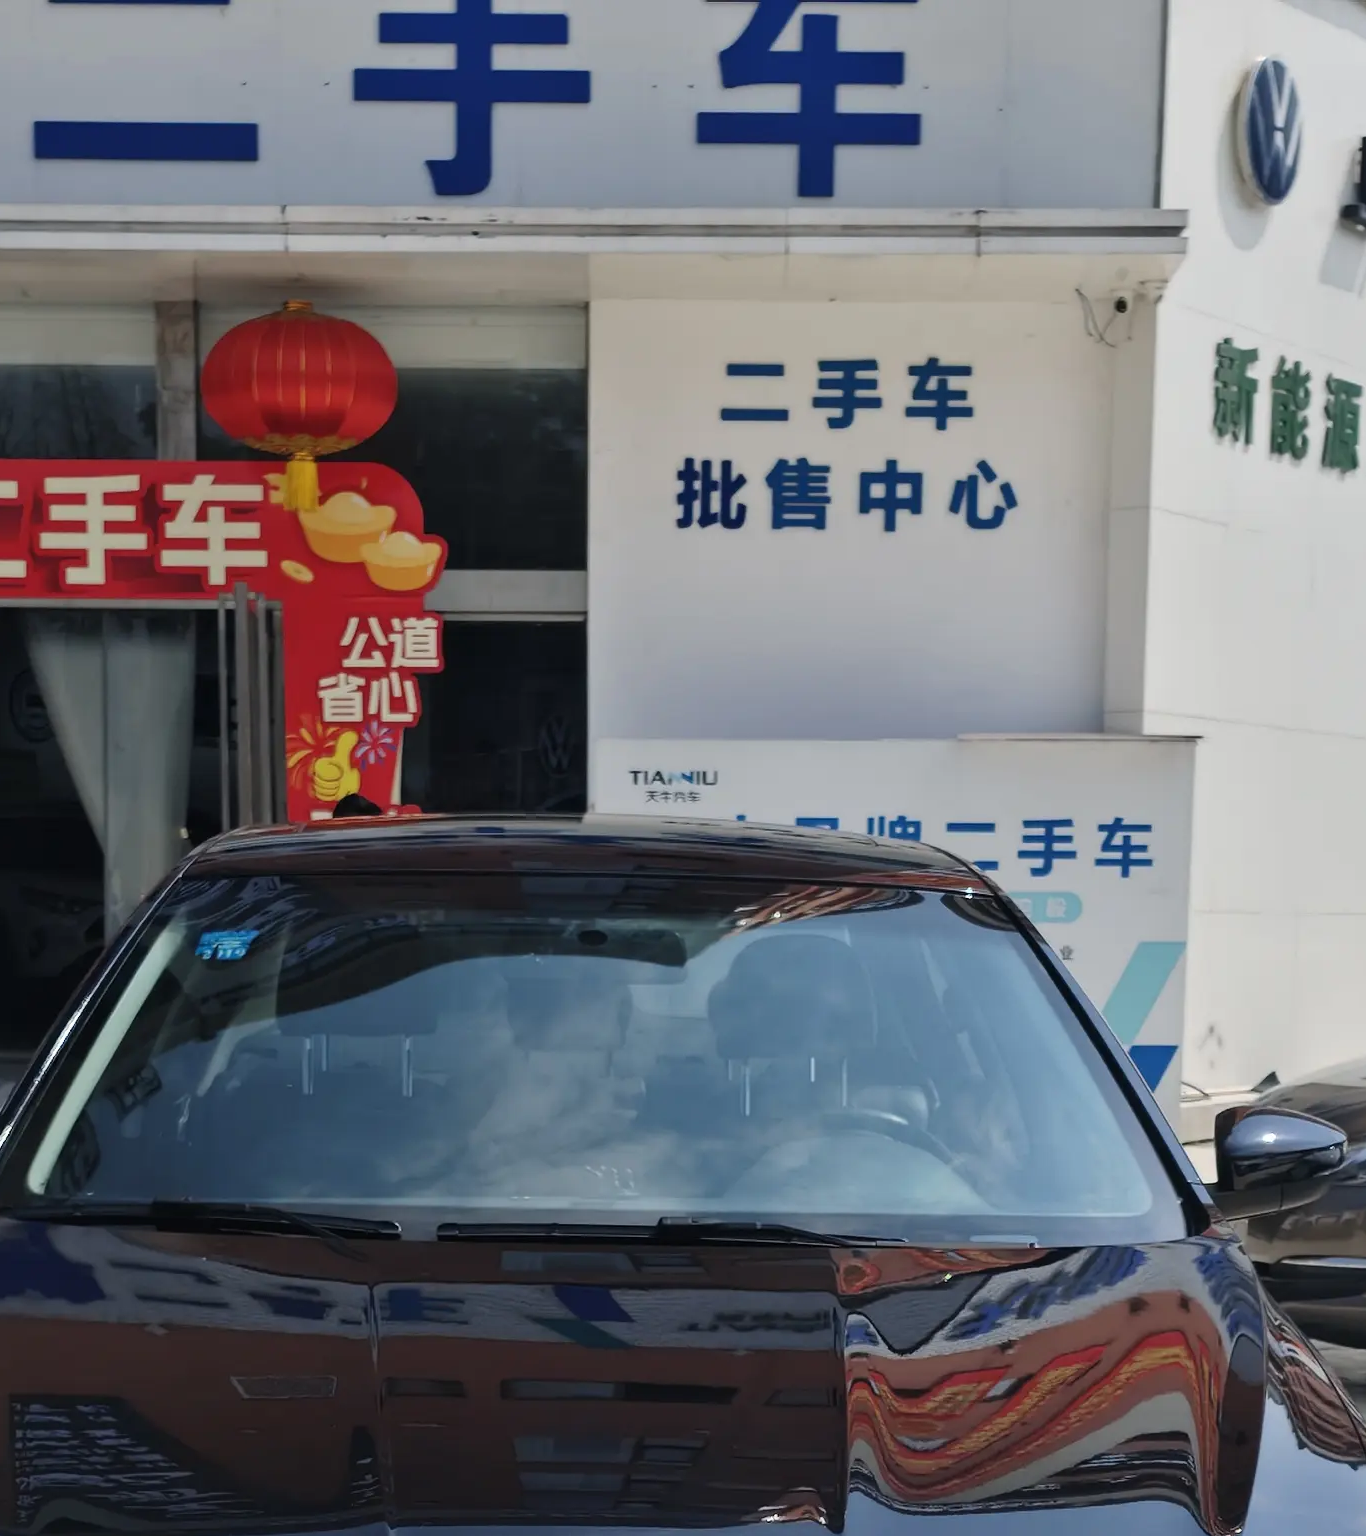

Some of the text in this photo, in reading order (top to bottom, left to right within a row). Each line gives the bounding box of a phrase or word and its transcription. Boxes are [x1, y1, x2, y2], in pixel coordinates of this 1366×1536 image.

[718, 357, 976, 431] 二手车
[674, 456, 1019, 533] 批售中心
[339, 617, 440, 668] 公道
[317, 671, 418, 723] 省心
